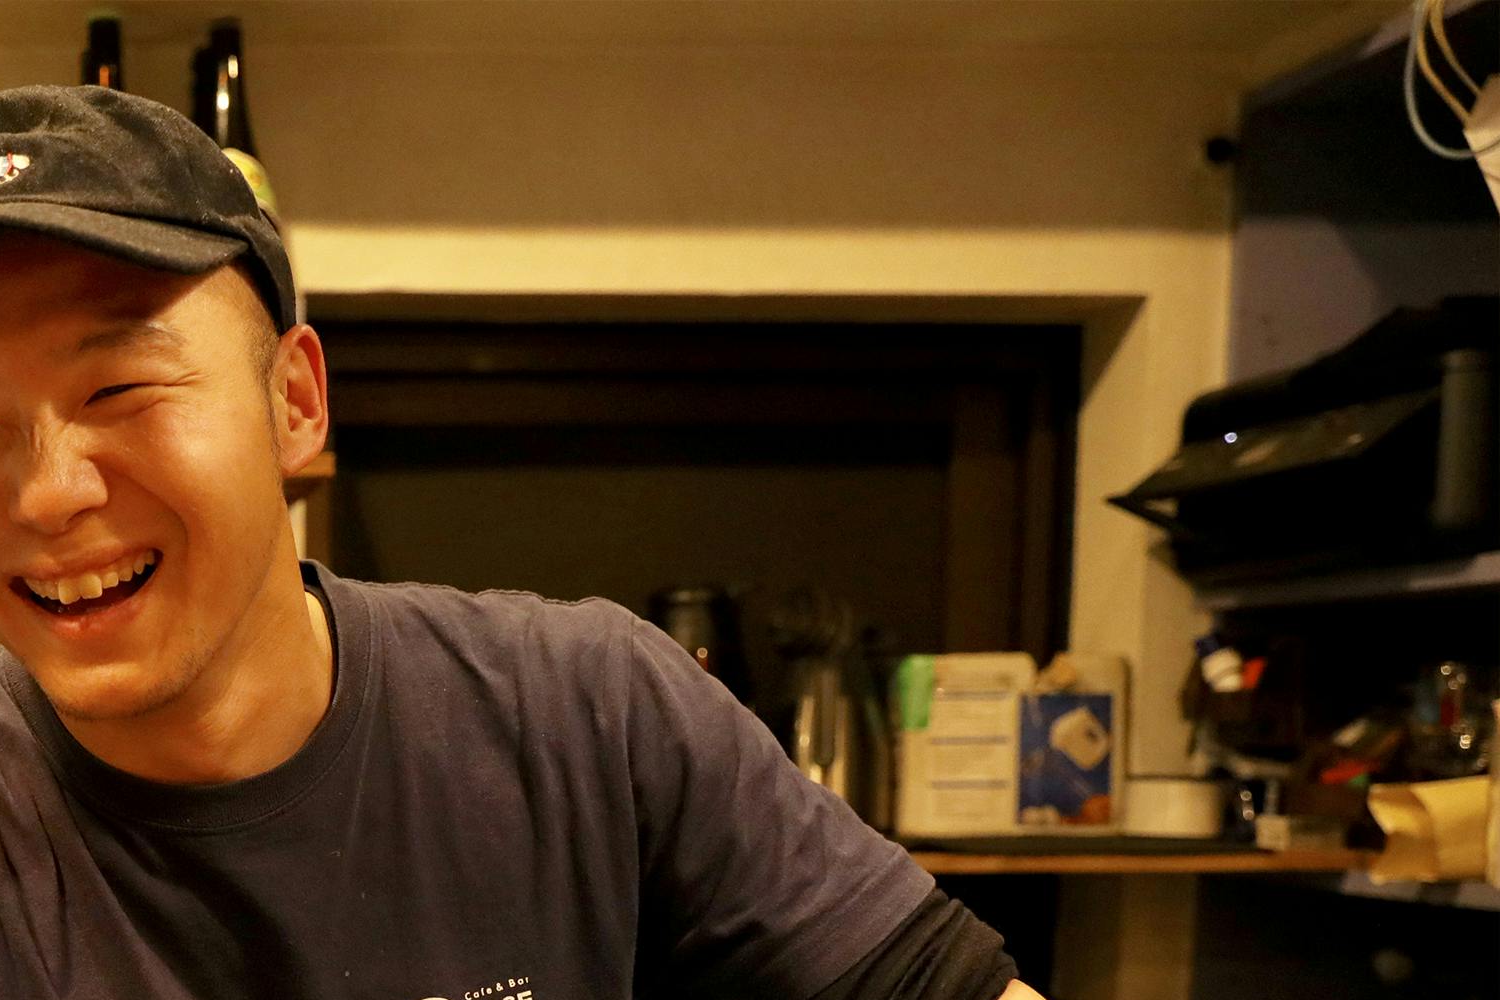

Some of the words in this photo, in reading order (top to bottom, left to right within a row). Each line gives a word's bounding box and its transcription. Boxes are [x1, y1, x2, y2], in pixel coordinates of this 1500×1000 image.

[464, 987, 493, 1000] Cafe
[495, 982, 504, 992] &
[508, 976, 529, 988] Bar
